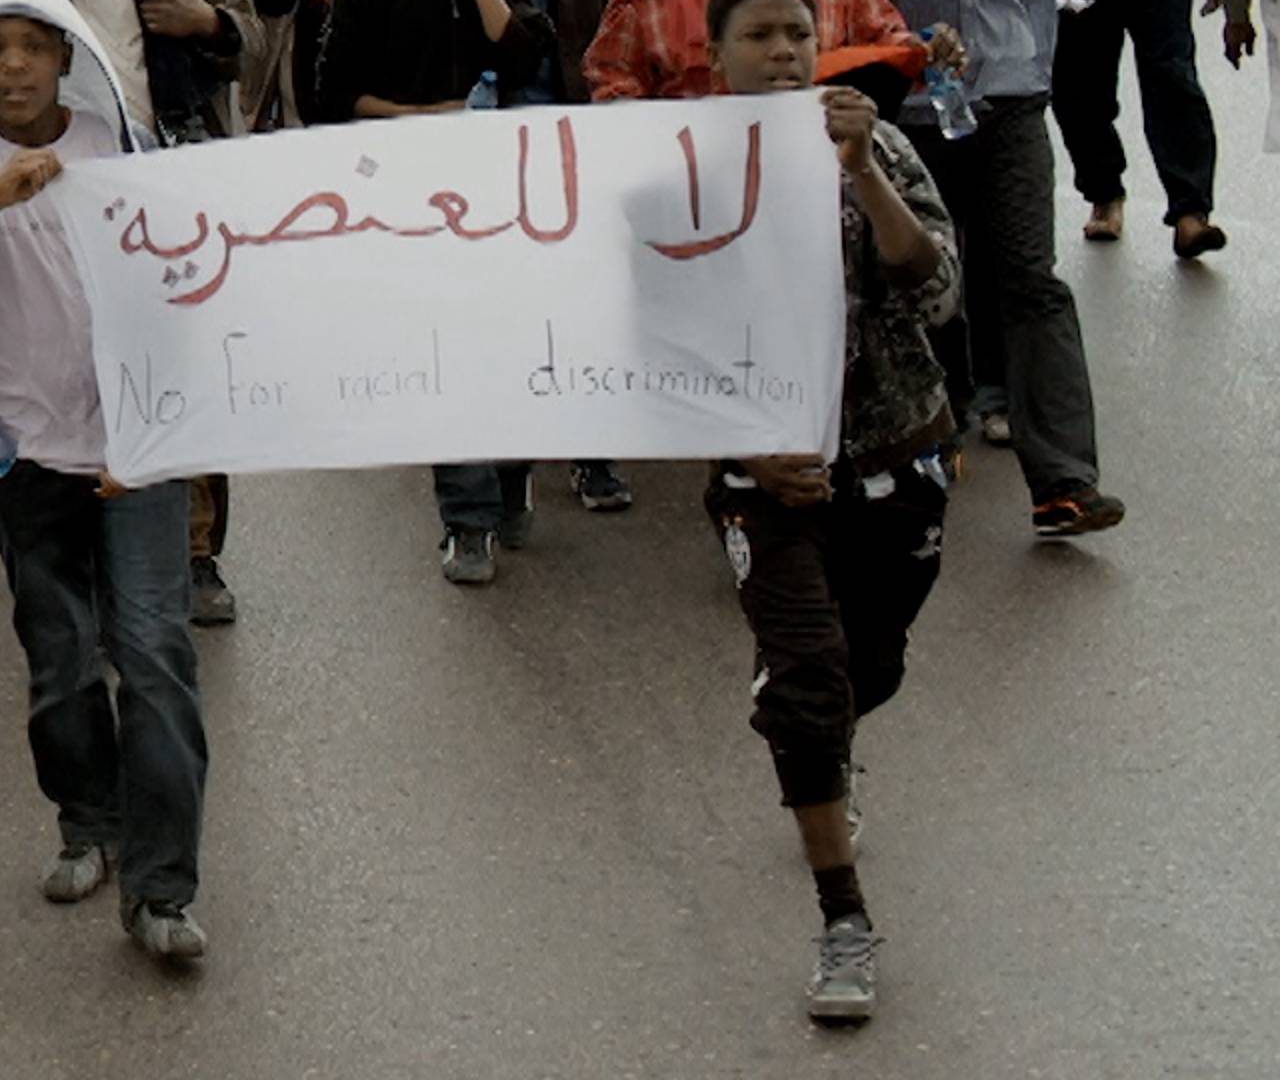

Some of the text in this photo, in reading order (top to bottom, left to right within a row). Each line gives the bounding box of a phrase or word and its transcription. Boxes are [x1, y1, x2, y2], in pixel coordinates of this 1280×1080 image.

[103, 115, 762, 306] لا للعنصرية
[114, 353, 187, 435] No
[337, 329, 443, 400] racial
[527, 320, 805, 406] discrimination
